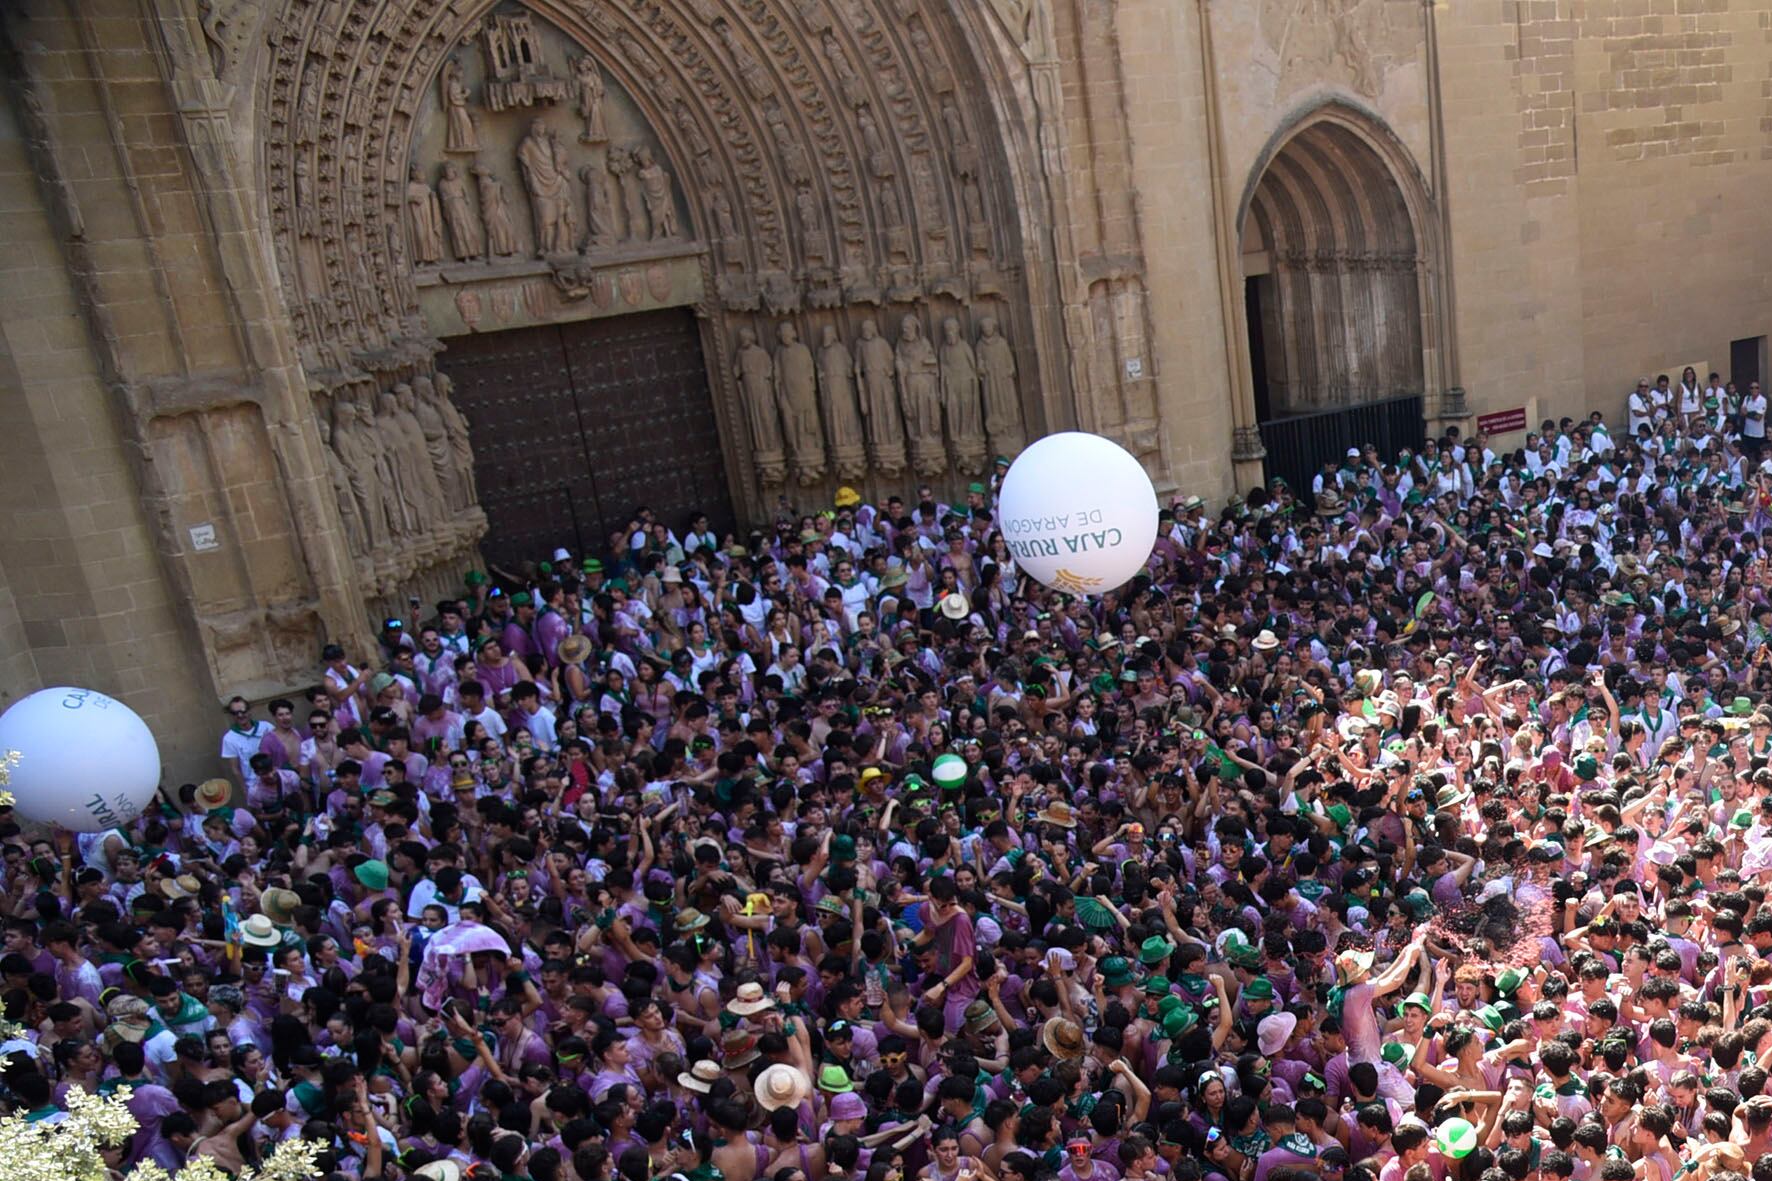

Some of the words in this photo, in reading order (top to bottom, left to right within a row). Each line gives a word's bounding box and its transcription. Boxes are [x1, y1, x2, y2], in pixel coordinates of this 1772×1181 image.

[1076, 509, 1103, 528] DE
[1005, 538, 1059, 558] RURA
[1064, 527, 1122, 554] CAJA
[62, 687, 91, 710] CAJ
[86, 793, 121, 828] URAL
